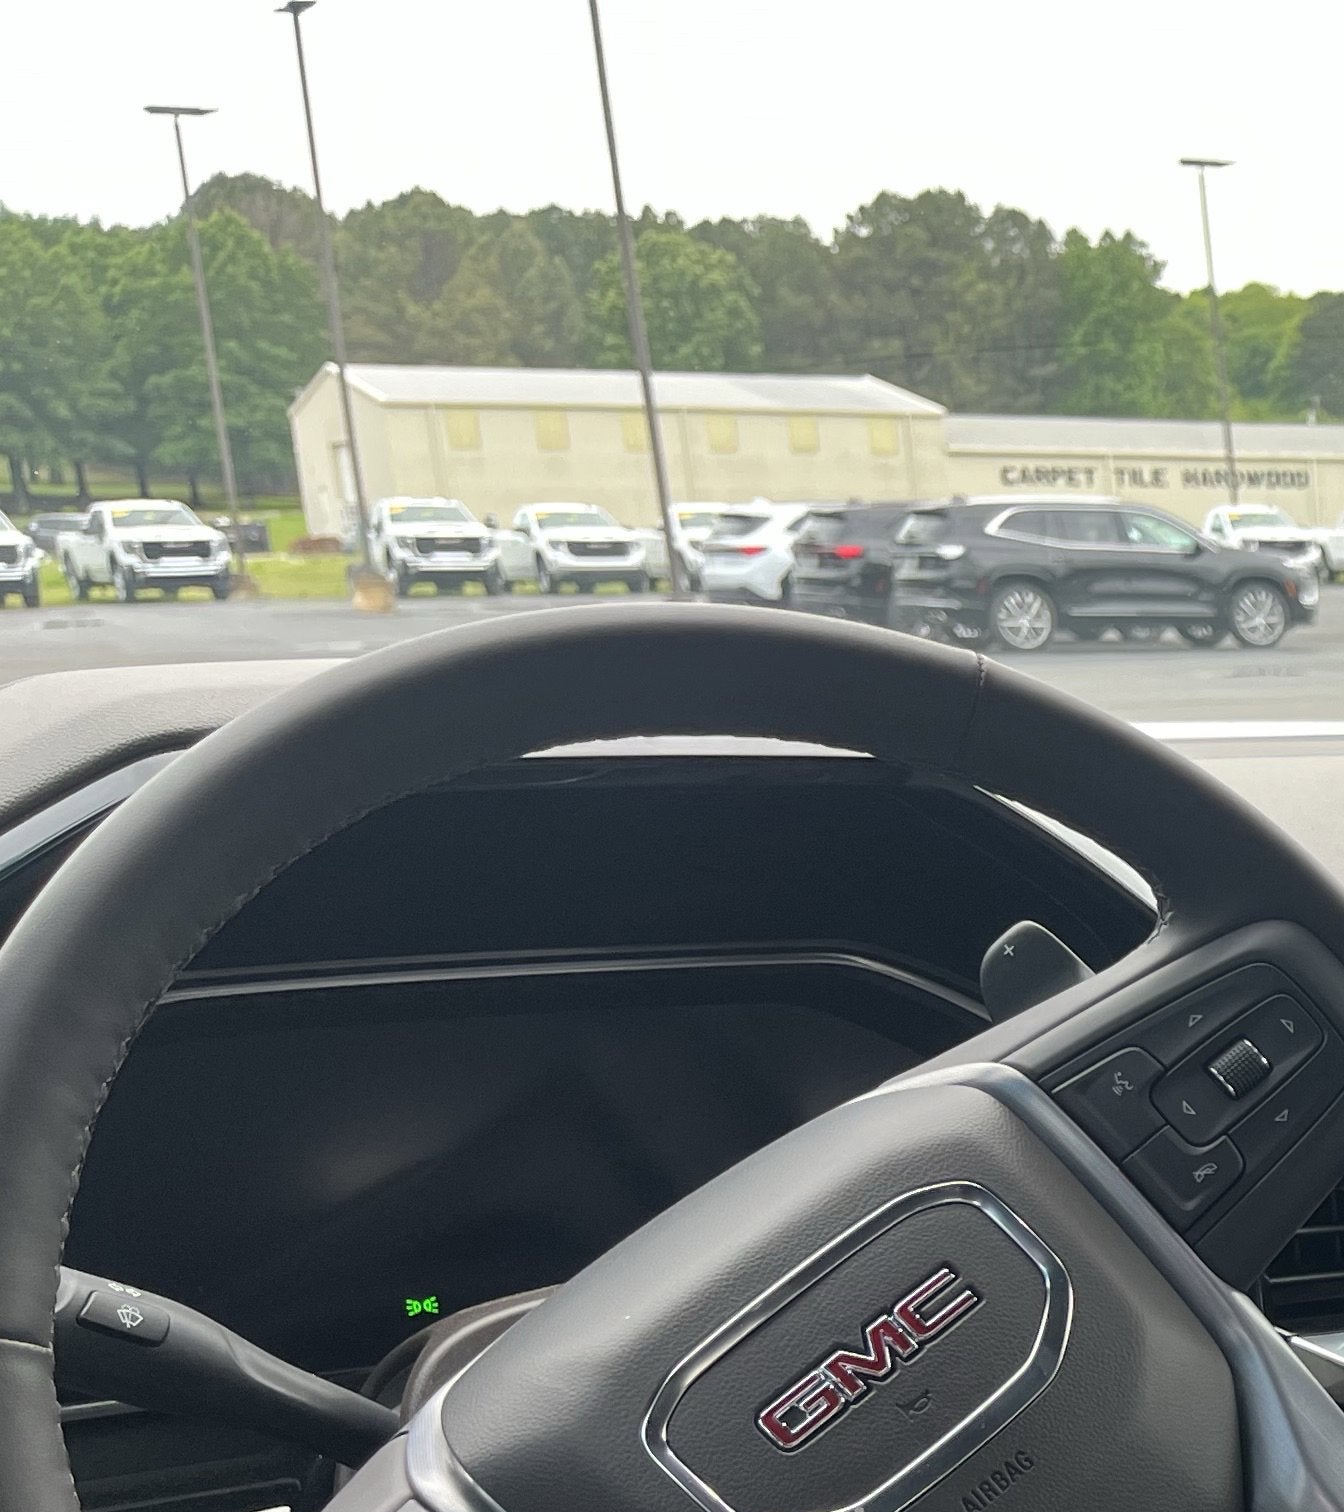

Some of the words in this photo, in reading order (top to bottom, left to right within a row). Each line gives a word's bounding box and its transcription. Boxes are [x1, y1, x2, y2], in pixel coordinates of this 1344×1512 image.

[1002, 465, 1095, 488] CARPET
[1113, 466, 1169, 489] TILE
[758, 1266, 978, 1448] GMC
